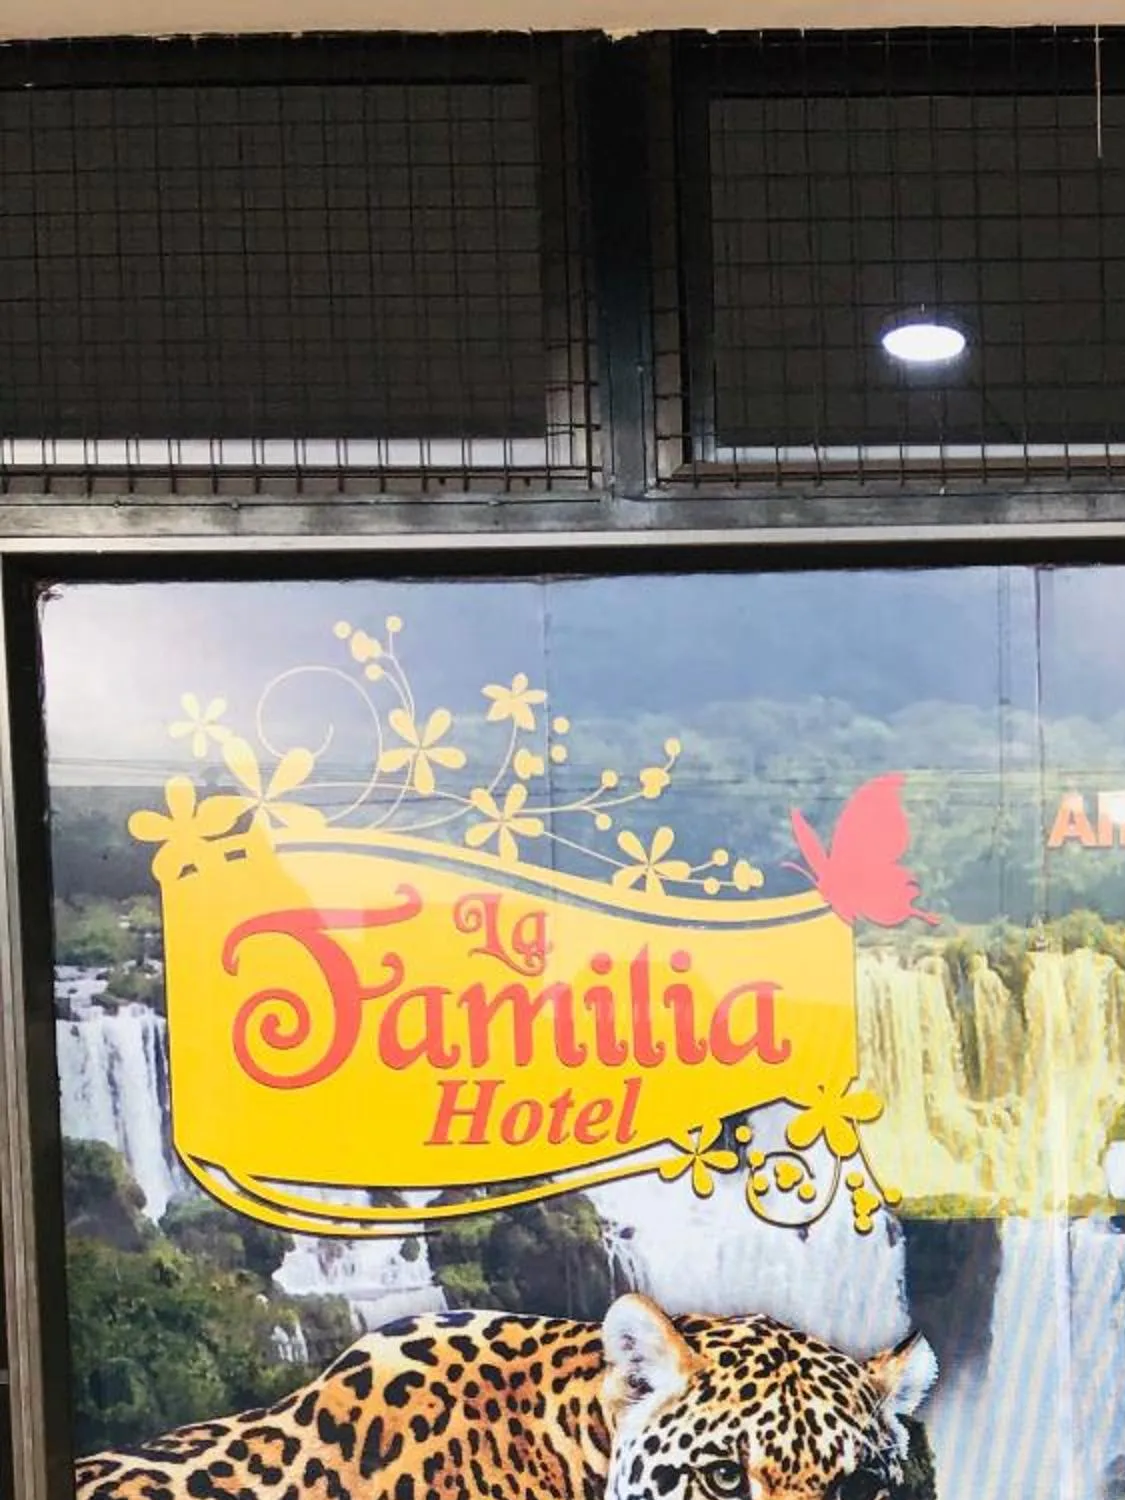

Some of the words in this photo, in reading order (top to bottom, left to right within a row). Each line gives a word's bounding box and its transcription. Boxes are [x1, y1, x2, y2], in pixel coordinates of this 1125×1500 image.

[455, 891, 554, 976] La
[221, 884, 792, 1090] Familia
[423, 1076, 644, 1147] Hotel
